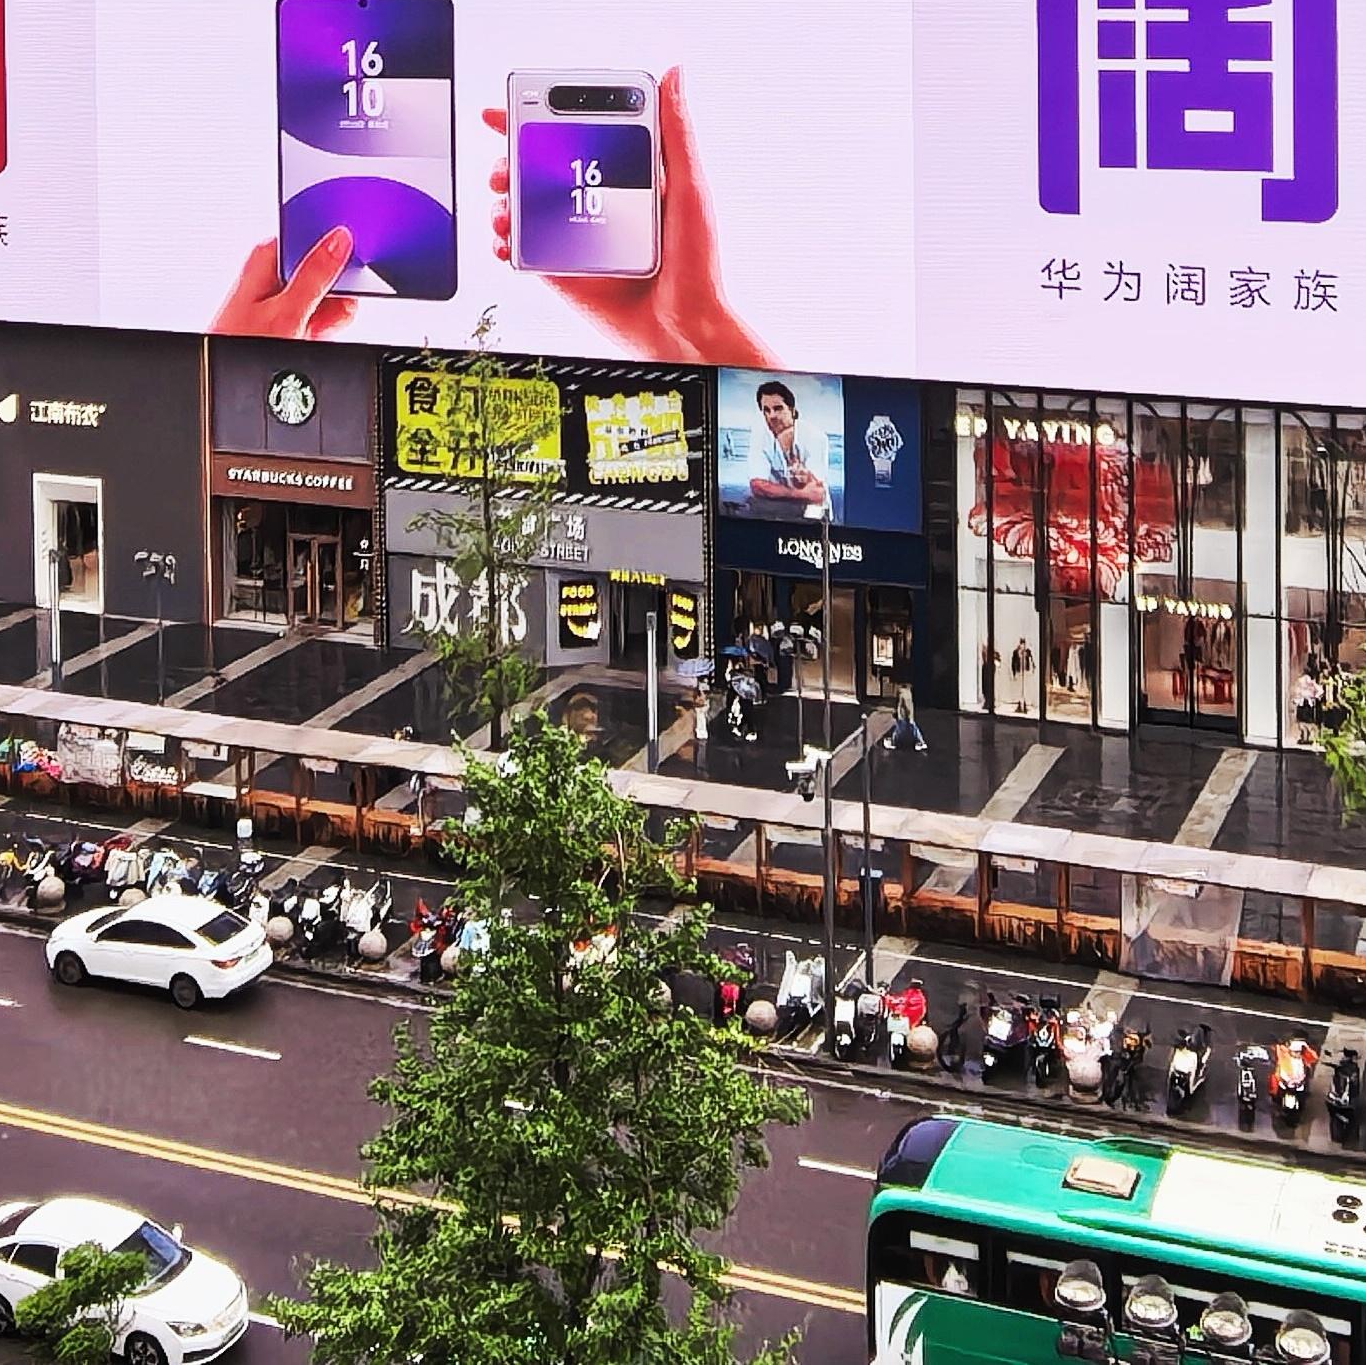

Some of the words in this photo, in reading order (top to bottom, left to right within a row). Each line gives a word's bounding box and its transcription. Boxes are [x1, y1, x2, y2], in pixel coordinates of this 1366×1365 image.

[341, 39, 383, 76] 16
[343, 80, 384, 117] 10
[571, 159, 602, 186] 16
[571, 188, 603, 215] 10
[1041, 258, 1338, 311] 华为阔家族
[29, 400, 101, 427] 江南布衣
[955, 415, 988, 438] EP
[227, 467, 303, 486] STARBUCKS
[305, 475, 353, 491] COFFEE
[778, 537, 862, 564] LONGNES
